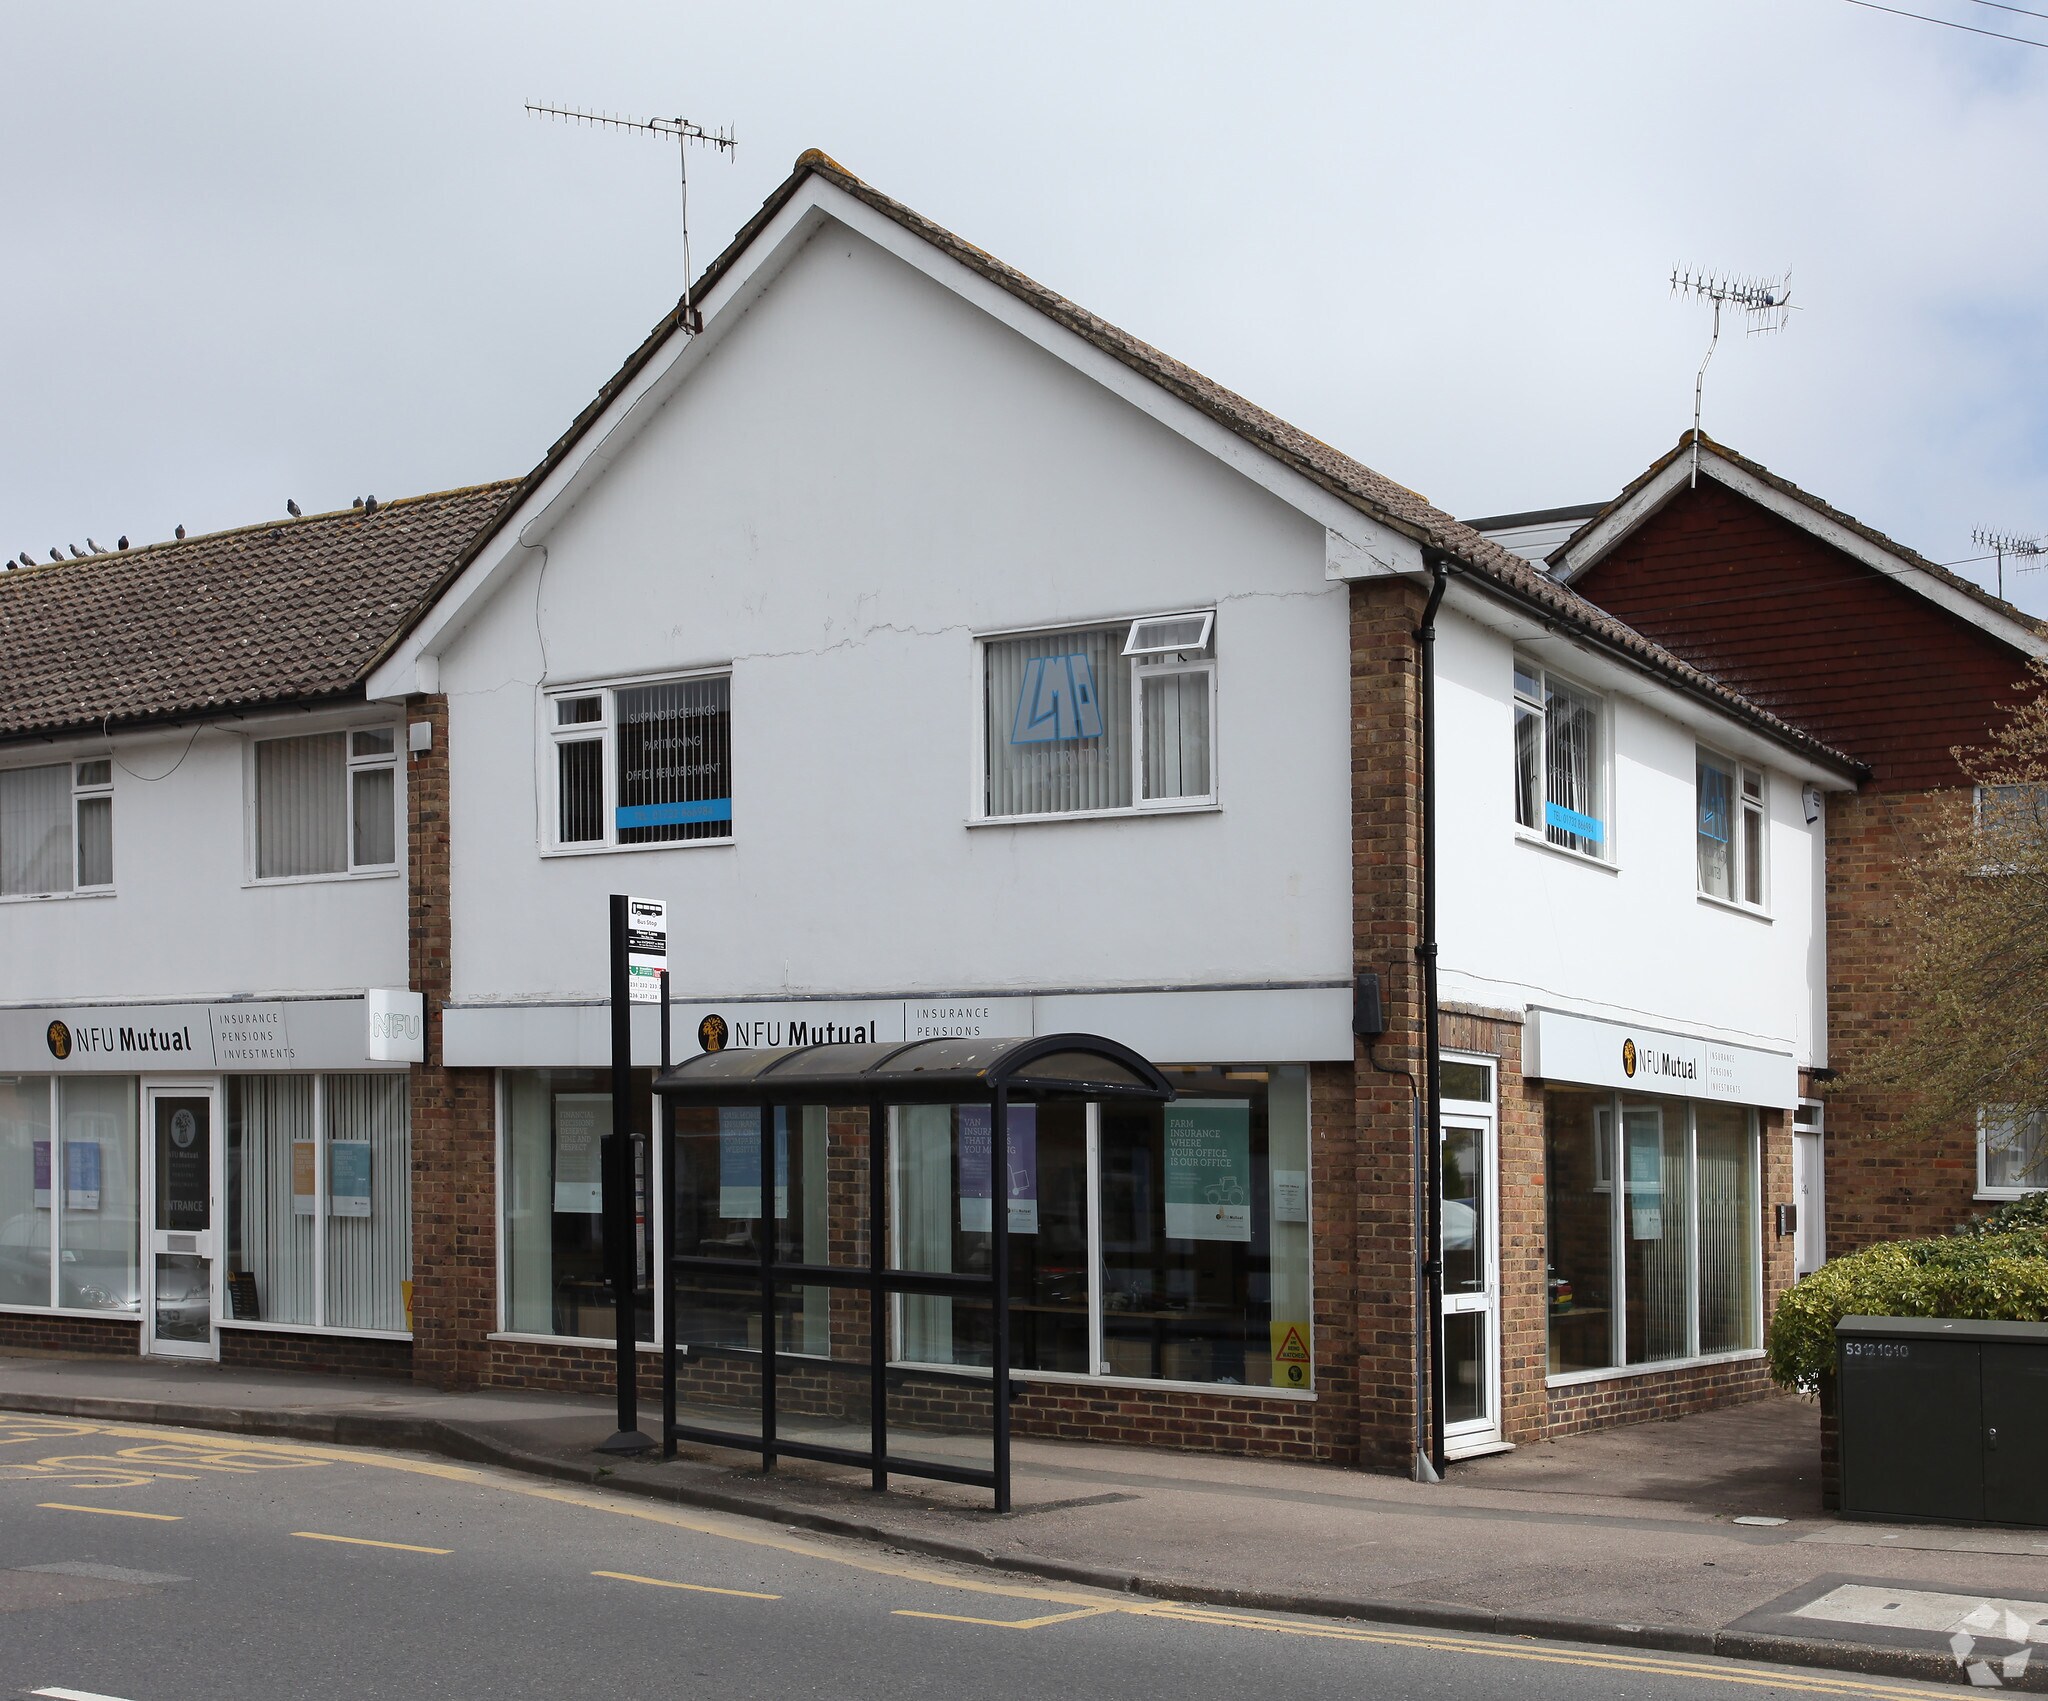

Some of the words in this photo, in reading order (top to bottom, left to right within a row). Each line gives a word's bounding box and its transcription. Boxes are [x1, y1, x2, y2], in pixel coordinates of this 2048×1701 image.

[917, 1008, 988, 1018] INSURANCE
[219, 1013, 278, 1024] INSURANCE
[374, 1012, 419, 1040] NFU
[917, 1026, 980, 1036] PENSIONS
[222, 1031, 273, 1041] PENSIONS
[736, 1021, 780, 1046] NFU
[788, 1020, 876, 1046] Mutual
[76, 1027, 114, 1052] NFU
[119, 1026, 192, 1051] Mutual
[224, 1048, 296, 1059] INVESTMENTS
[1709, 1050, 1735, 1064] INSURANCE
[1639, 1048, 1660, 1075] NFU
[1661, 1053, 1697, 1080] Mutual
[1710, 1067, 1733, 1078] PENSIONS
[1711, 1082, 1741, 1094] INVESTMENTS
[560, 1111, 595, 1119] FINANCIAL
[964, 1118, 981, 1126] VAN
[1170, 1119, 1194, 1128] FARM
[1170, 1129, 1221, 1138] INSURANCE
[577, 1135, 592, 1143] AND
[964, 1136, 987, 1145] THAT
[1170, 1138, 1202, 1147] WHERE
[964, 1145, 981, 1154] YOU
[1170, 1148, 1194, 1157] YOUR
[1195, 1148, 1228, 1158] OFFICE
[1170, 1157, 1179, 1166] IS
[1179, 1157, 1199, 1166] OUR
[1199, 1158, 1232, 1167] OFFICE
